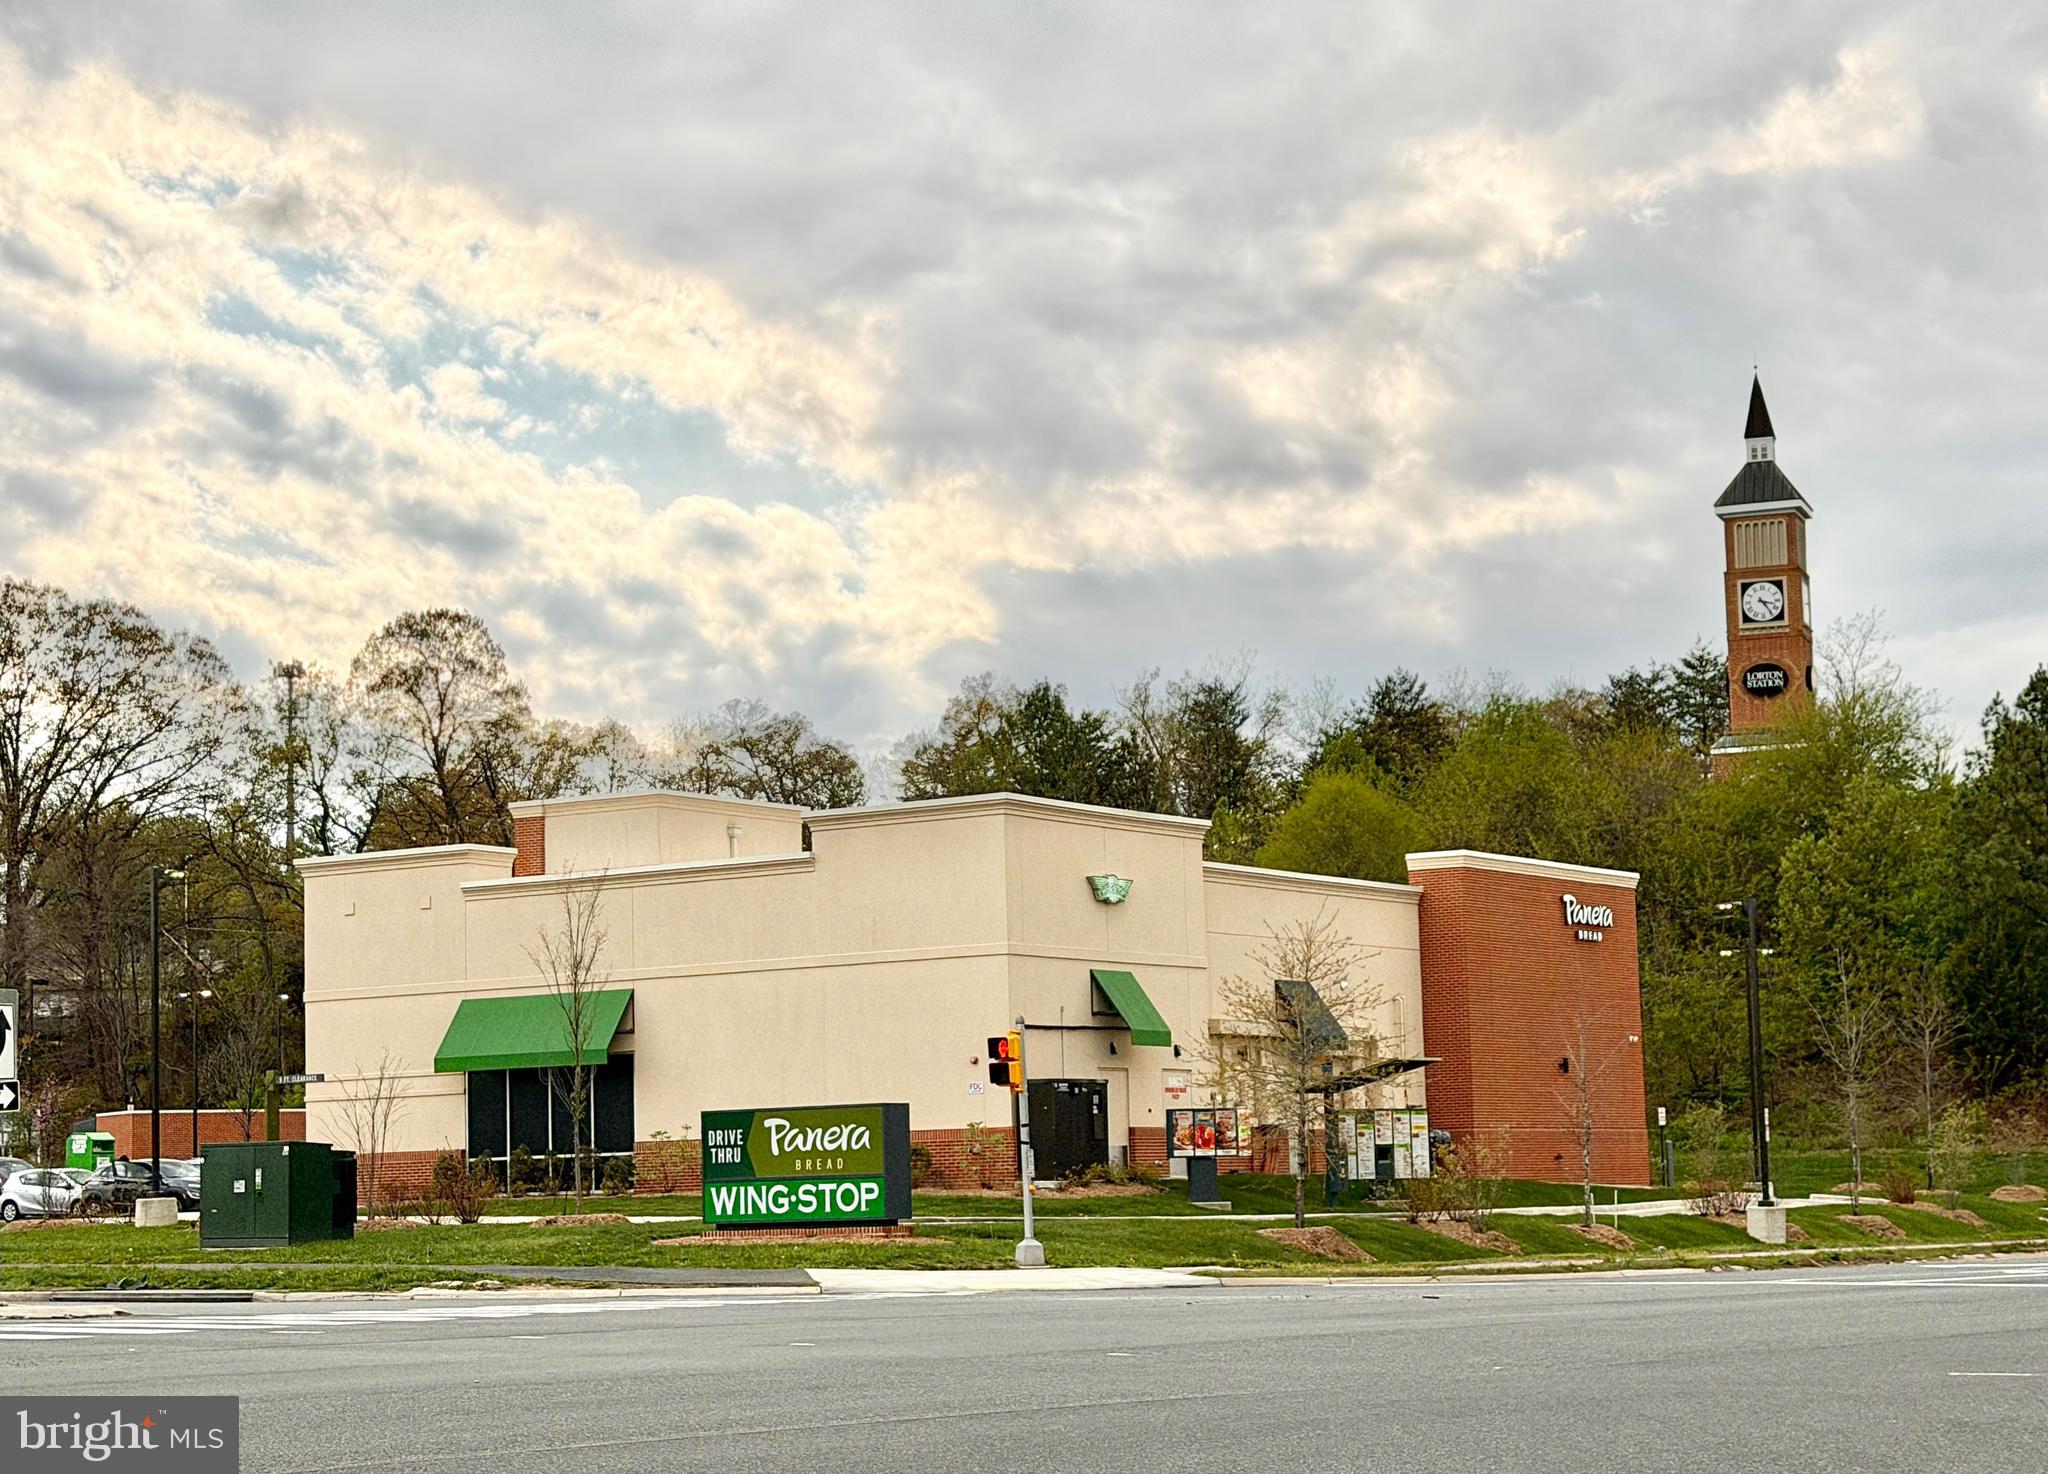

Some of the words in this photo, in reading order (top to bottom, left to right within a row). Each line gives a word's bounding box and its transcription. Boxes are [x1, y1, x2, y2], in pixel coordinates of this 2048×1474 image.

[1747, 671, 1783, 680] LORTON
[1747, 679, 1784, 688] STATION
[1563, 894, 1613, 927] Panera
[1578, 930, 1603, 942] BREAD
[970, 1082, 982, 1090] FDC
[708, 1129, 744, 1146] DRIVE
[763, 1118, 871, 1156] Panera
[711, 1147, 741, 1164] THRU
[795, 1158, 844, 1171] BREAD
